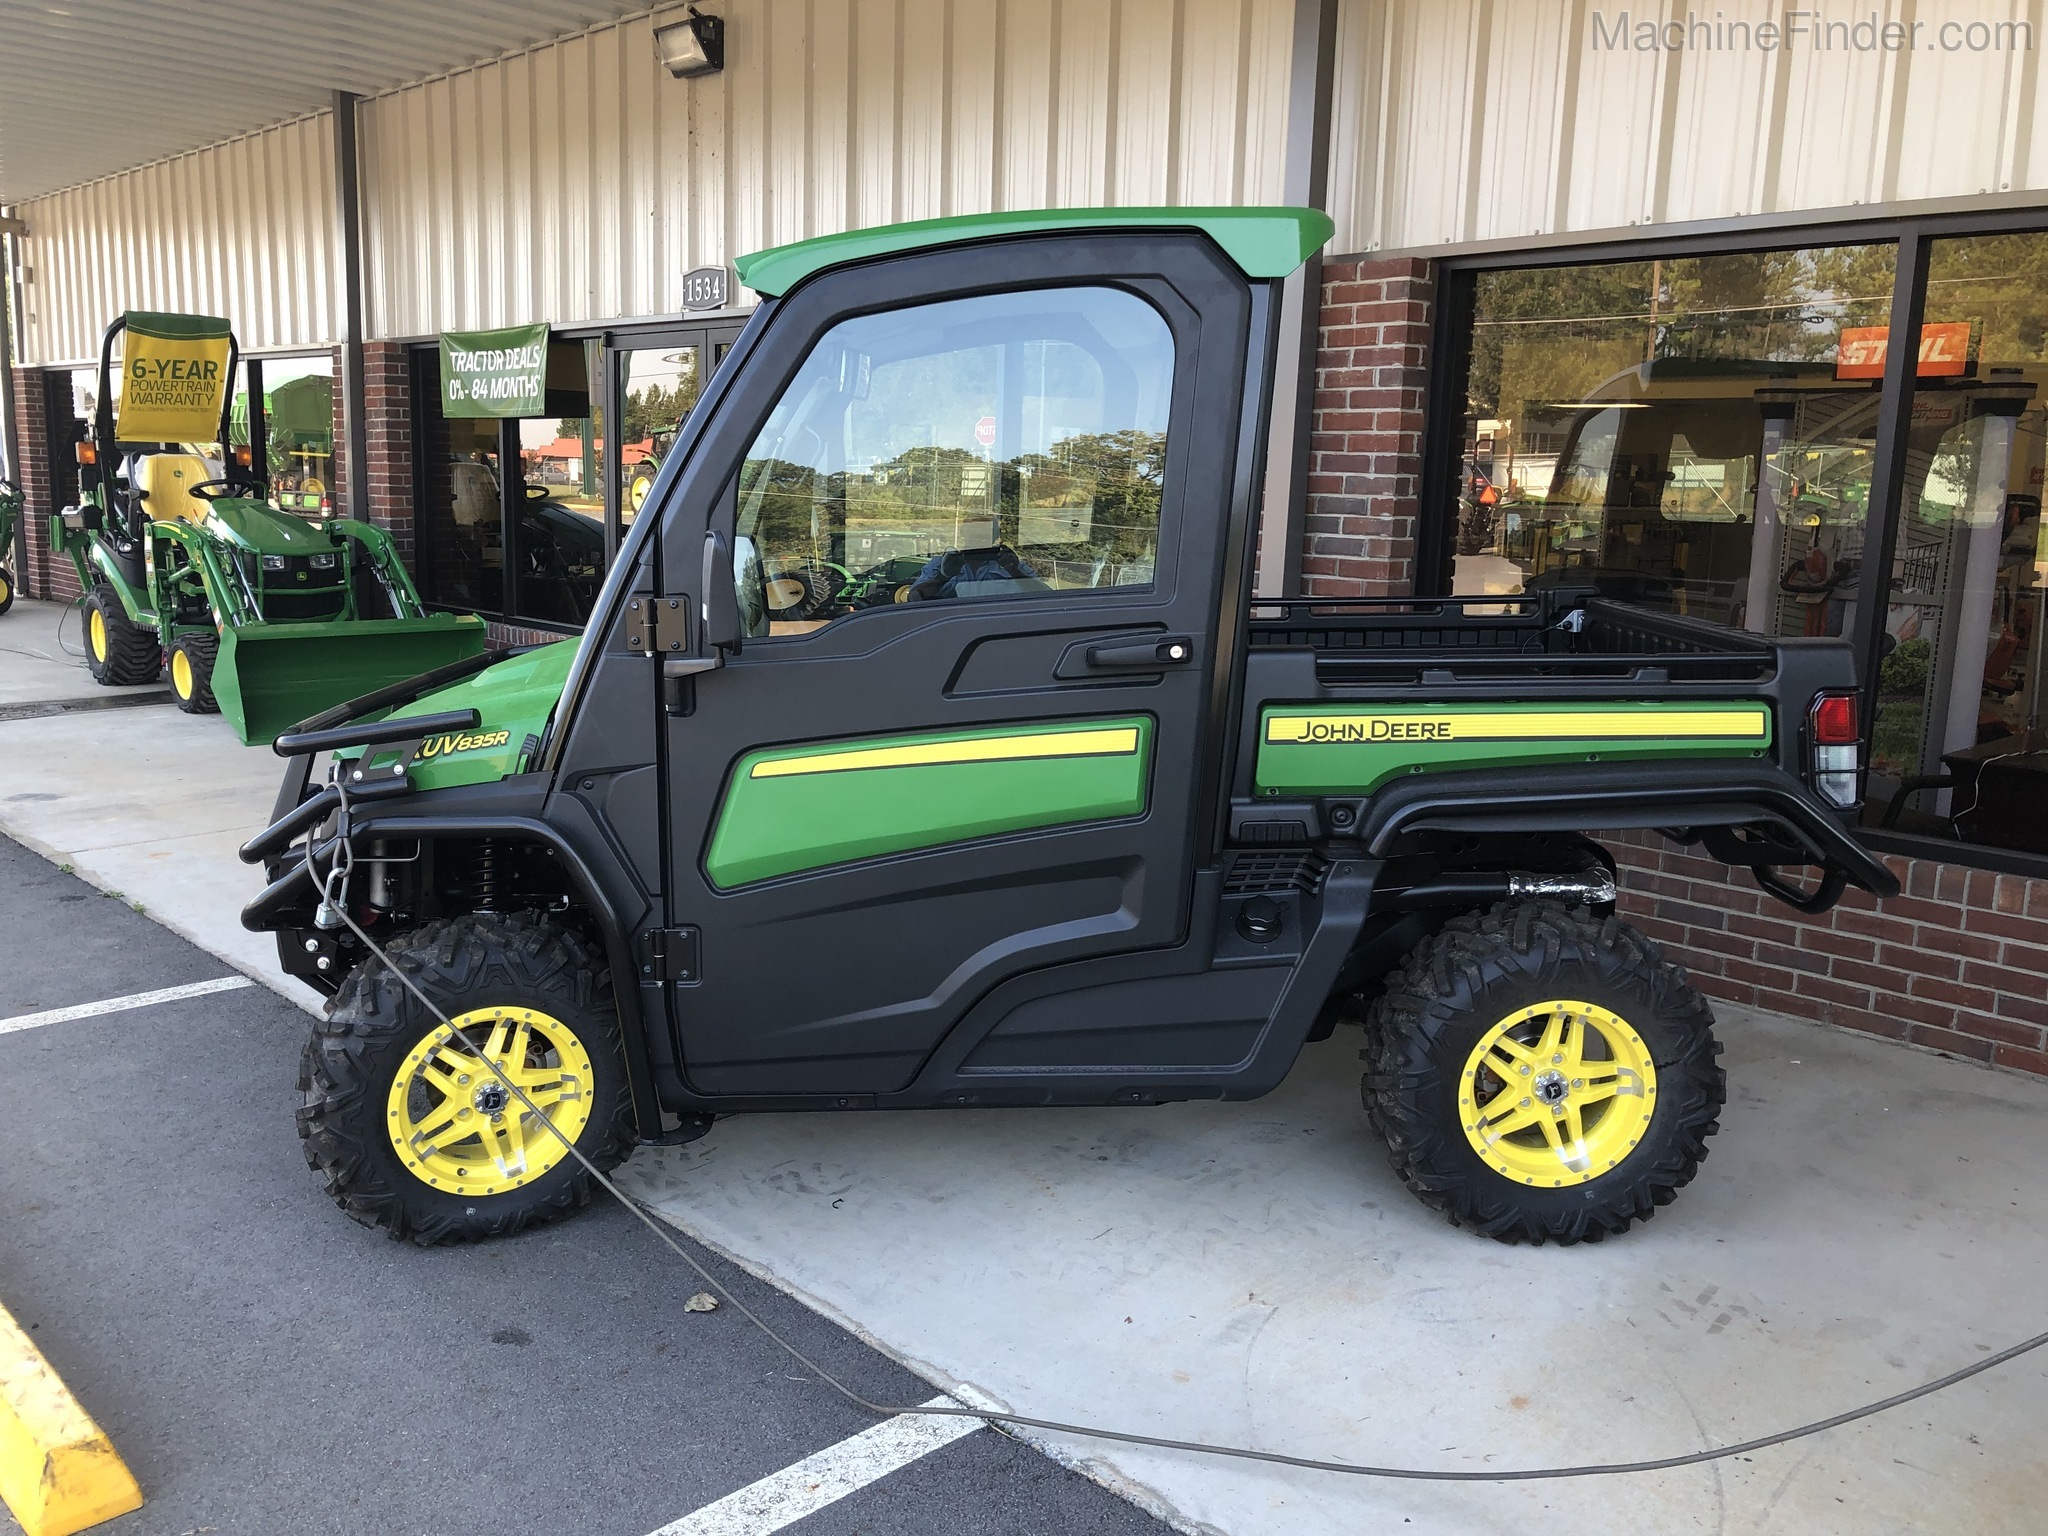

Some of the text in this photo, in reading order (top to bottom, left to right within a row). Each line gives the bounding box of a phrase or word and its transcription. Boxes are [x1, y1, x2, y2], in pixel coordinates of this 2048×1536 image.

[687, 276, 720, 301] 1534
[131, 358, 218, 380] 6-YEAR
[449, 345, 540, 372] TRACTOR DEALS
[130, 379, 216, 392] POWERTRAIN
[471, 378, 489, 400] 84
[130, 392, 215, 406] WARRANTY
